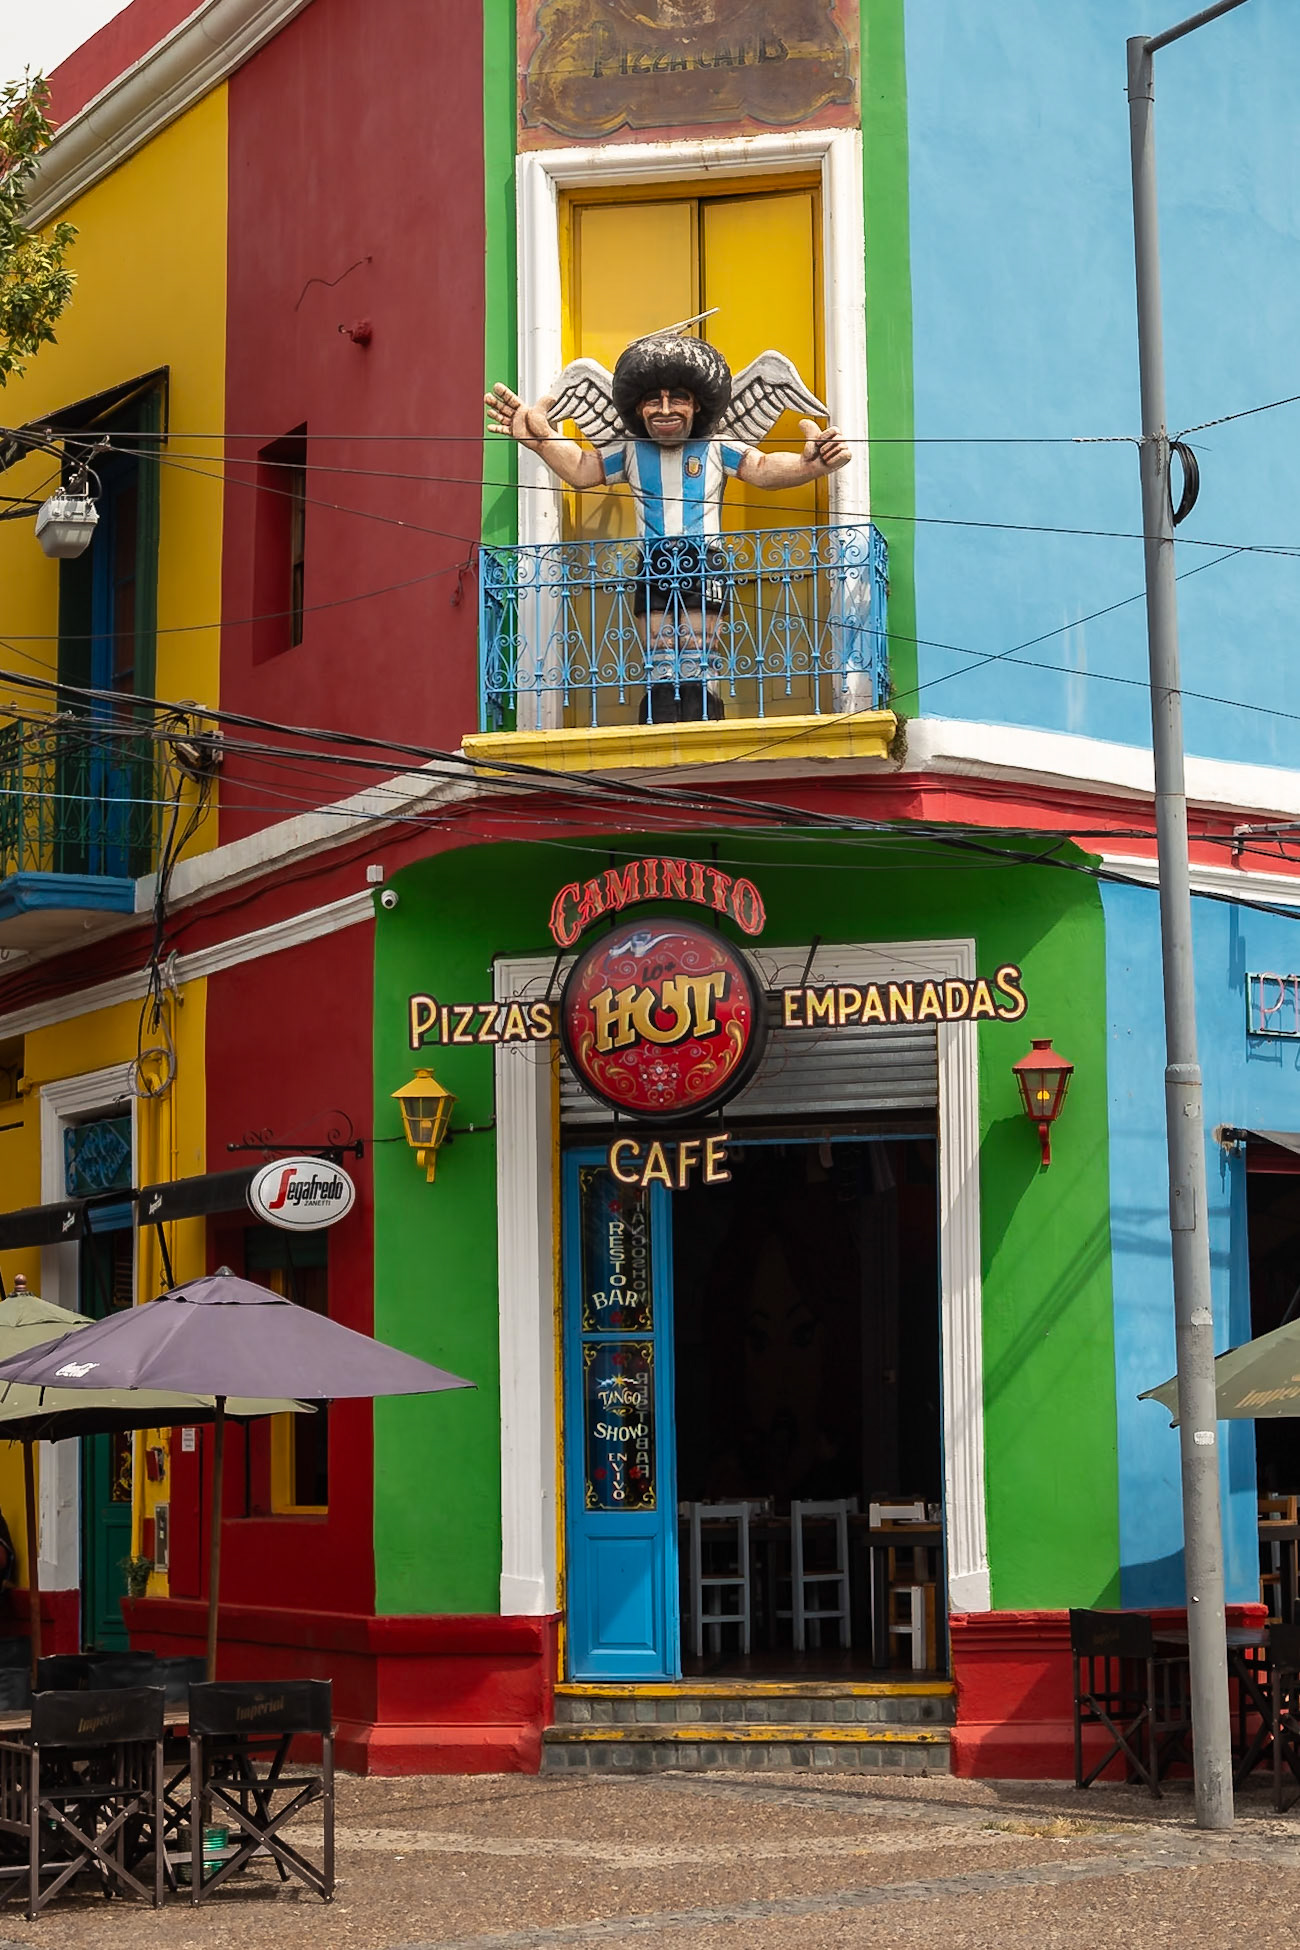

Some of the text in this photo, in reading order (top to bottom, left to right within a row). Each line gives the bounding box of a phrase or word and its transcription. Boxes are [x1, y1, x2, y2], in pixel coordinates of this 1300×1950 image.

[549, 858, 766, 948] CAMINITO
[590, 972, 730, 1053] HOT
[784, 966, 1027, 1027] EMPANADAS
[409, 994, 554, 1049] PIZZAS
[609, 1135, 732, 1190] CAFE
[268, 1168, 344, 1210] Segafredo
[592, 1288, 638, 1311] BAR
[598, 1386, 641, 1410] TANGO
[593, 1421, 642, 1442] SHOW
[608, 1452, 628, 1462] EN
[236, 1695, 285, 1721] Imperial
